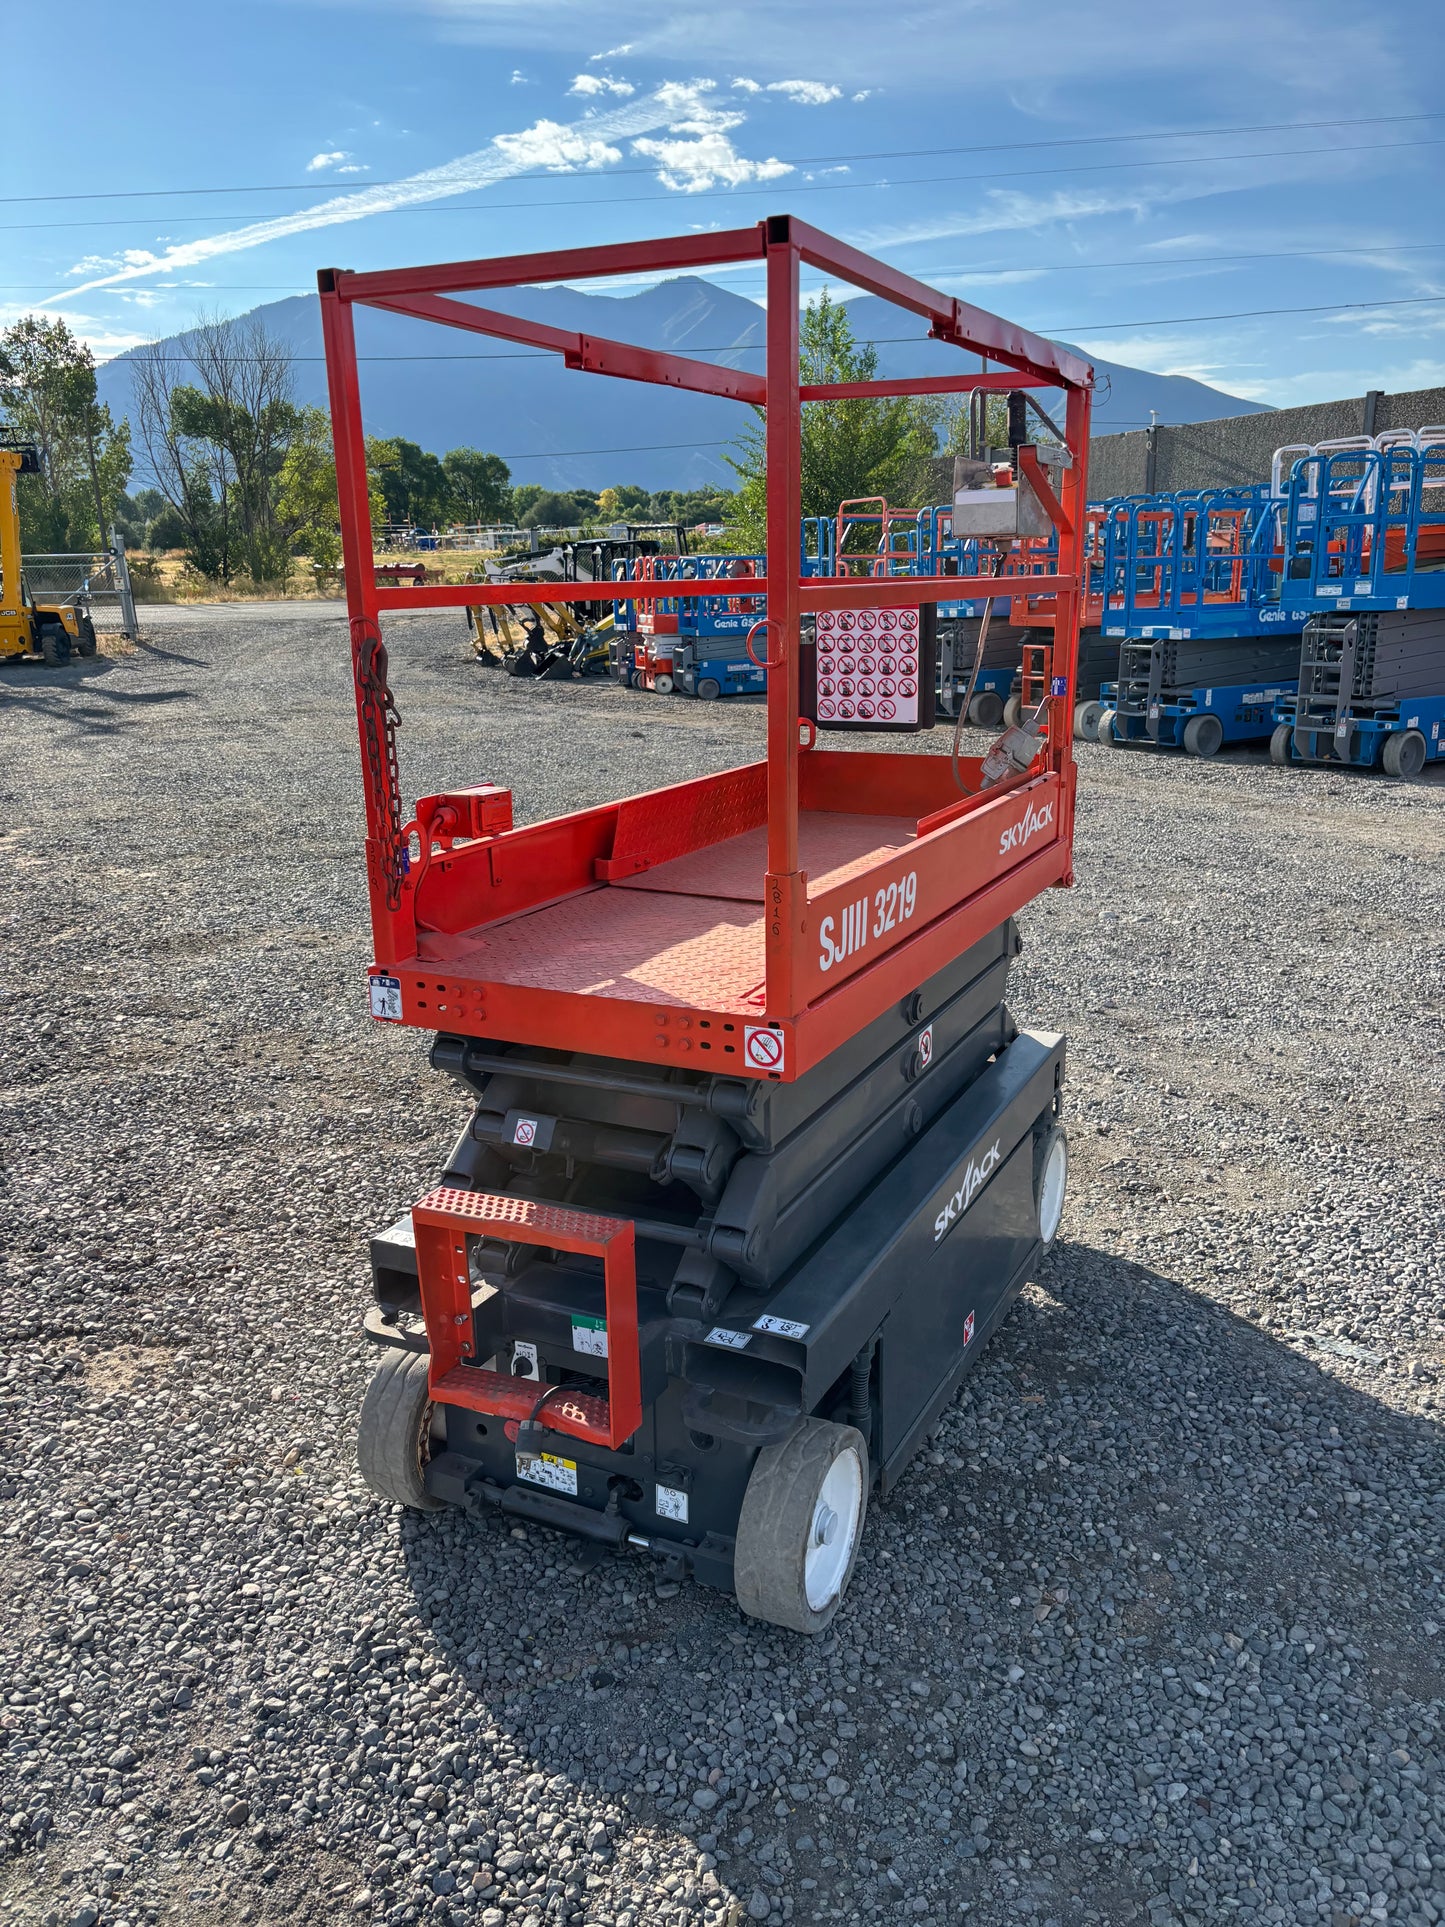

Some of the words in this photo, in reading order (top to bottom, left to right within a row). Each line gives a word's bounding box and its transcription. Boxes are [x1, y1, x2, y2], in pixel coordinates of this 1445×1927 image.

[714, 619, 739, 629] Genie
[1258, 609, 1286, 622] Genie
[998, 800, 1054, 856] SKYJACK
[771, 878, 784, 936] 2816
[819, 896, 868, 973] SJIII
[873, 871, 917, 939] 3219
[934, 1137, 1001, 1242] SKYJACK
